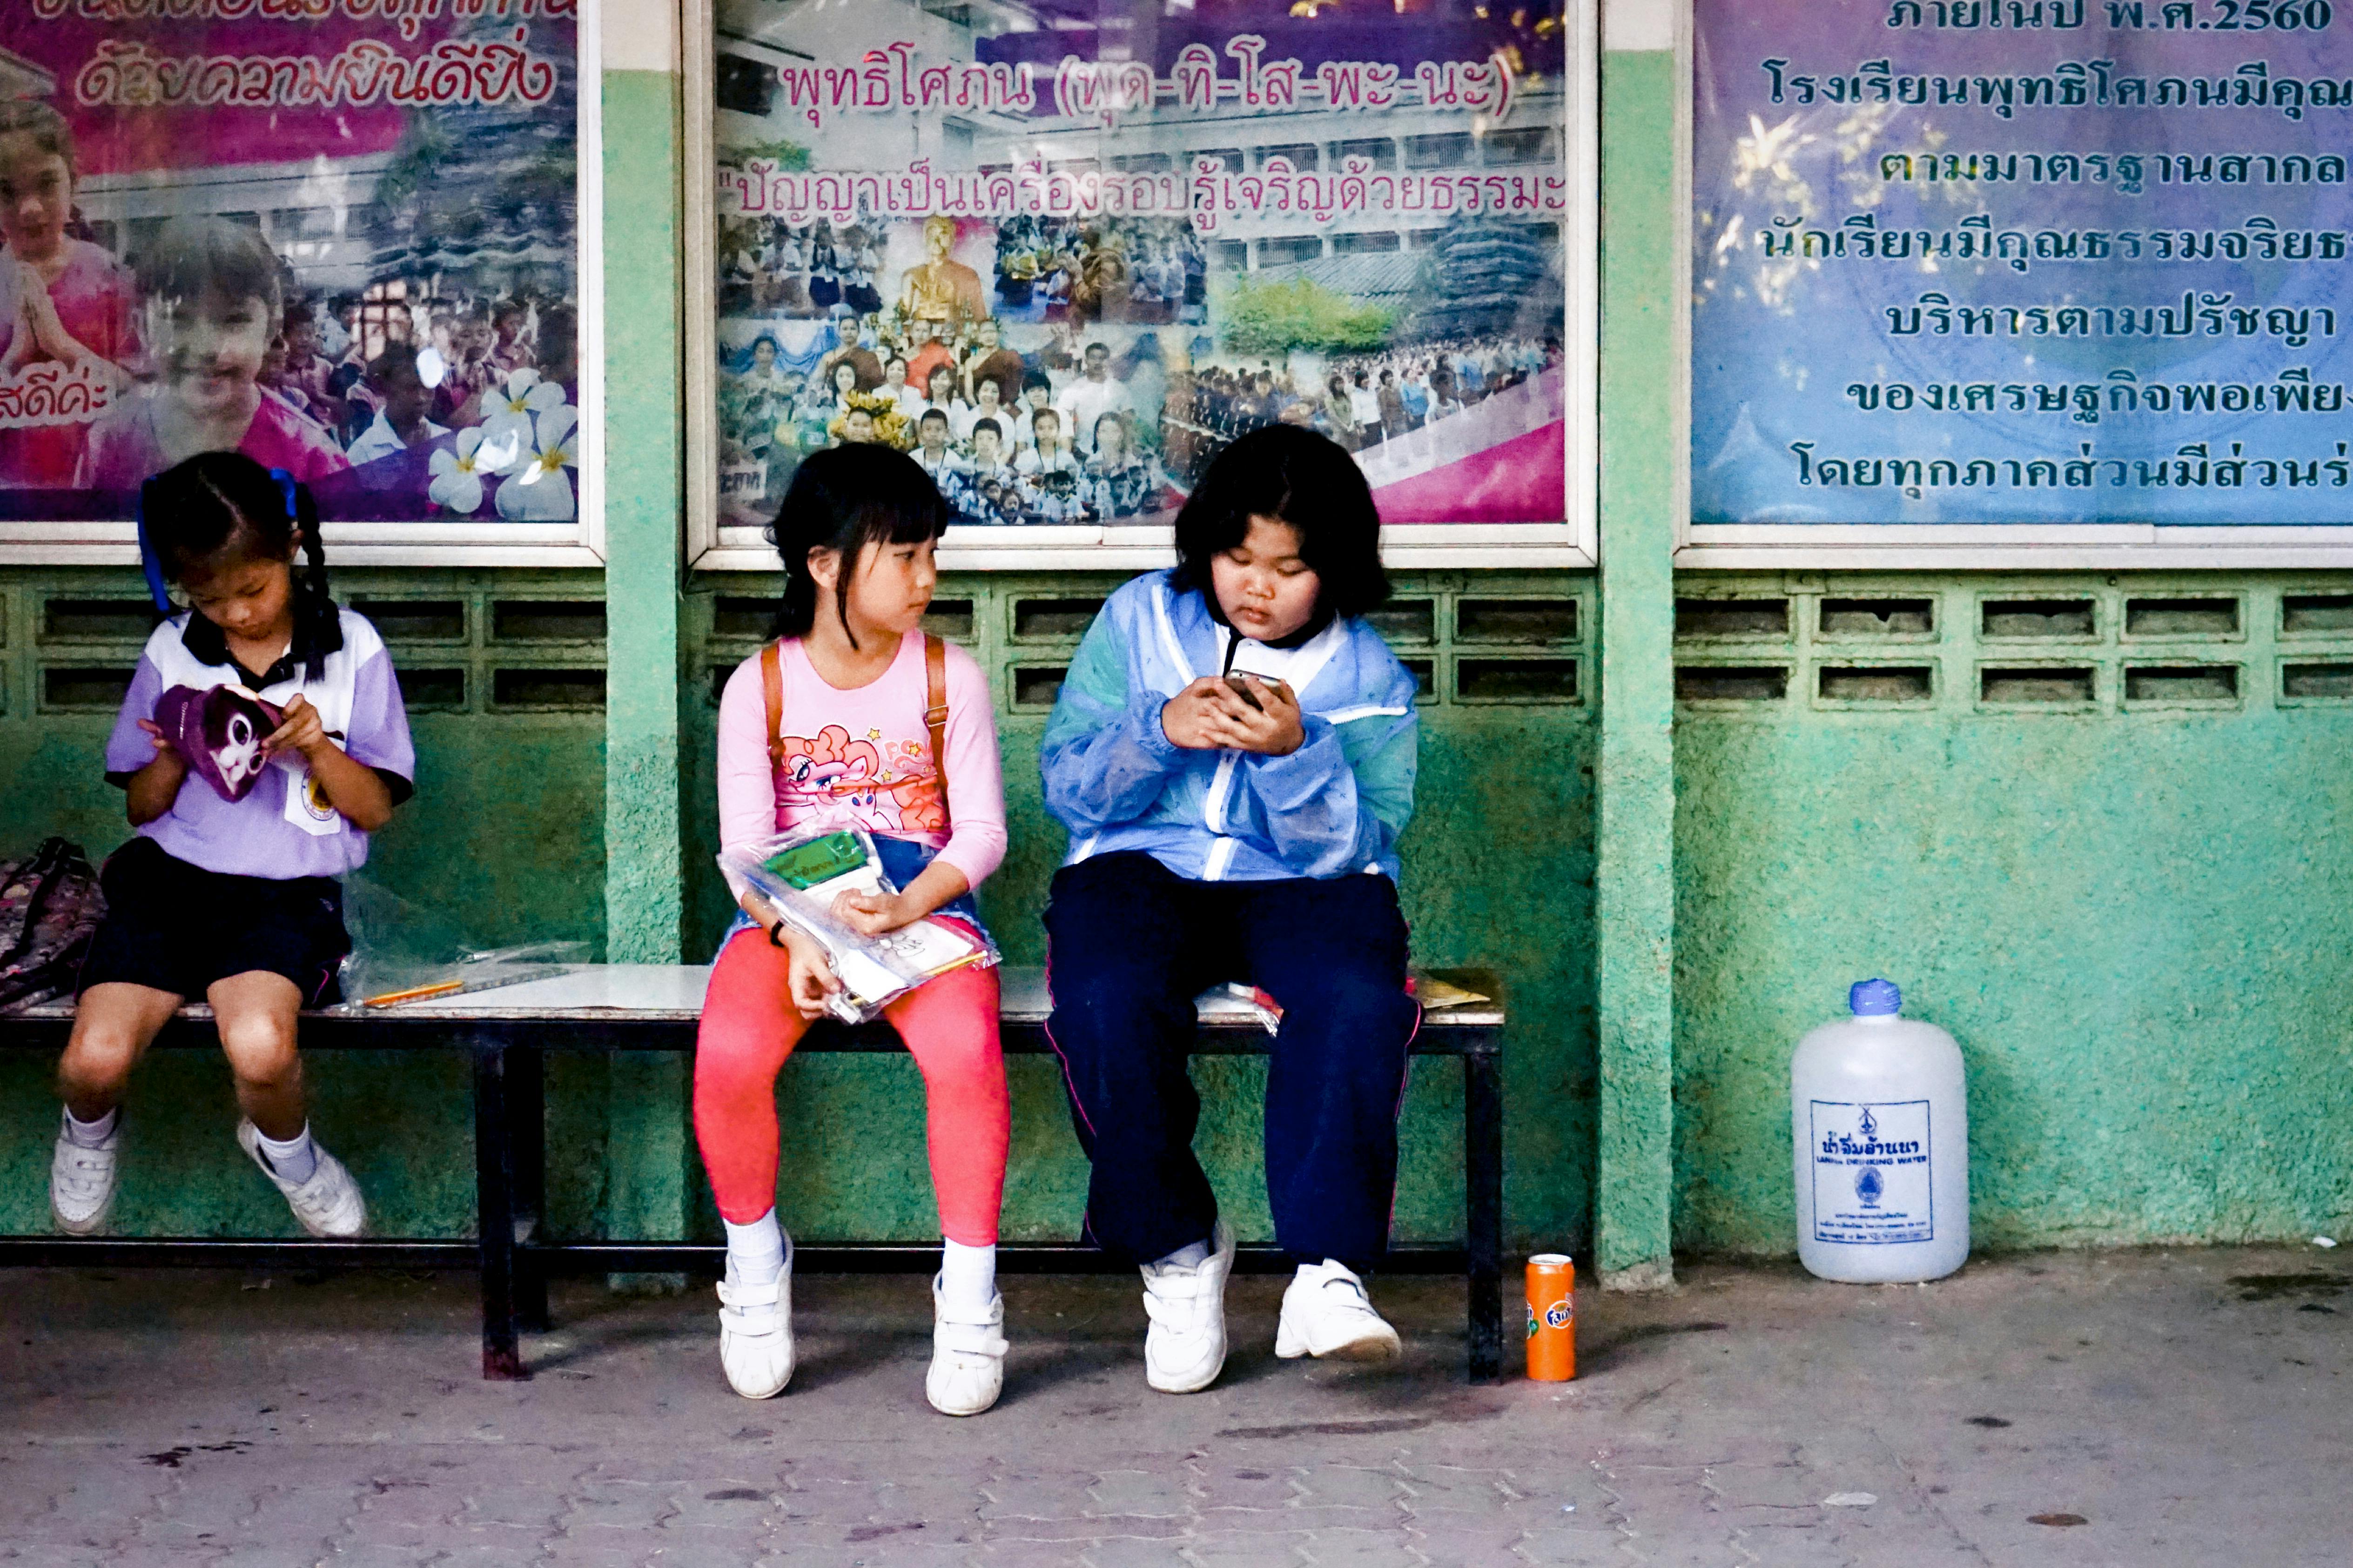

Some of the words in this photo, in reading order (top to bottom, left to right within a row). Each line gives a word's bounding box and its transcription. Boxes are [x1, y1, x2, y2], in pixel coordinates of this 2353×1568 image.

[783, 42, 1030, 128] พุทธิโศภน
[1880, 153, 2345, 193] ตามมาตรฐานสากล
[1761, 214, 2353, 272] นักเรียนมีคุณธรรมจริยธ
[1886, 293, 2334, 346] บริหารตามปรัชญา
[1847, 367, 2353, 422] ของเศรษฐกิจพอเพีย
[1897, 1155, 1927, 1165] WATER
